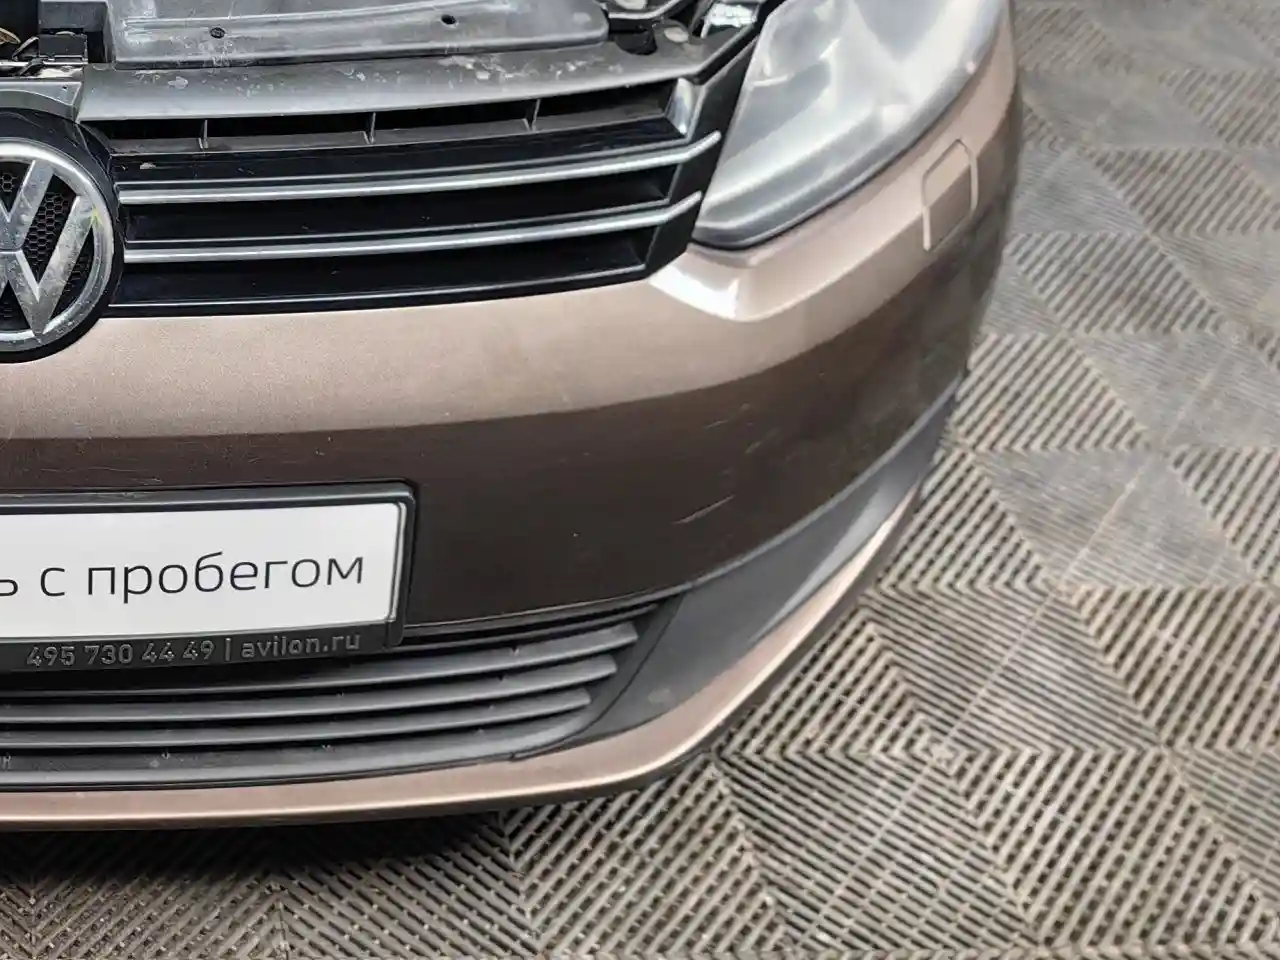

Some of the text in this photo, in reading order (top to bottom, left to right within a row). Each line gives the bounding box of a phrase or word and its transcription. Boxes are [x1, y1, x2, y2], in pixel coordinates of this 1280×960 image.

[40, 567, 66, 597] с
[87, 551, 364, 604] пробегом
[25, 632, 361, 668] 495 730 44 49 avilon.ru
